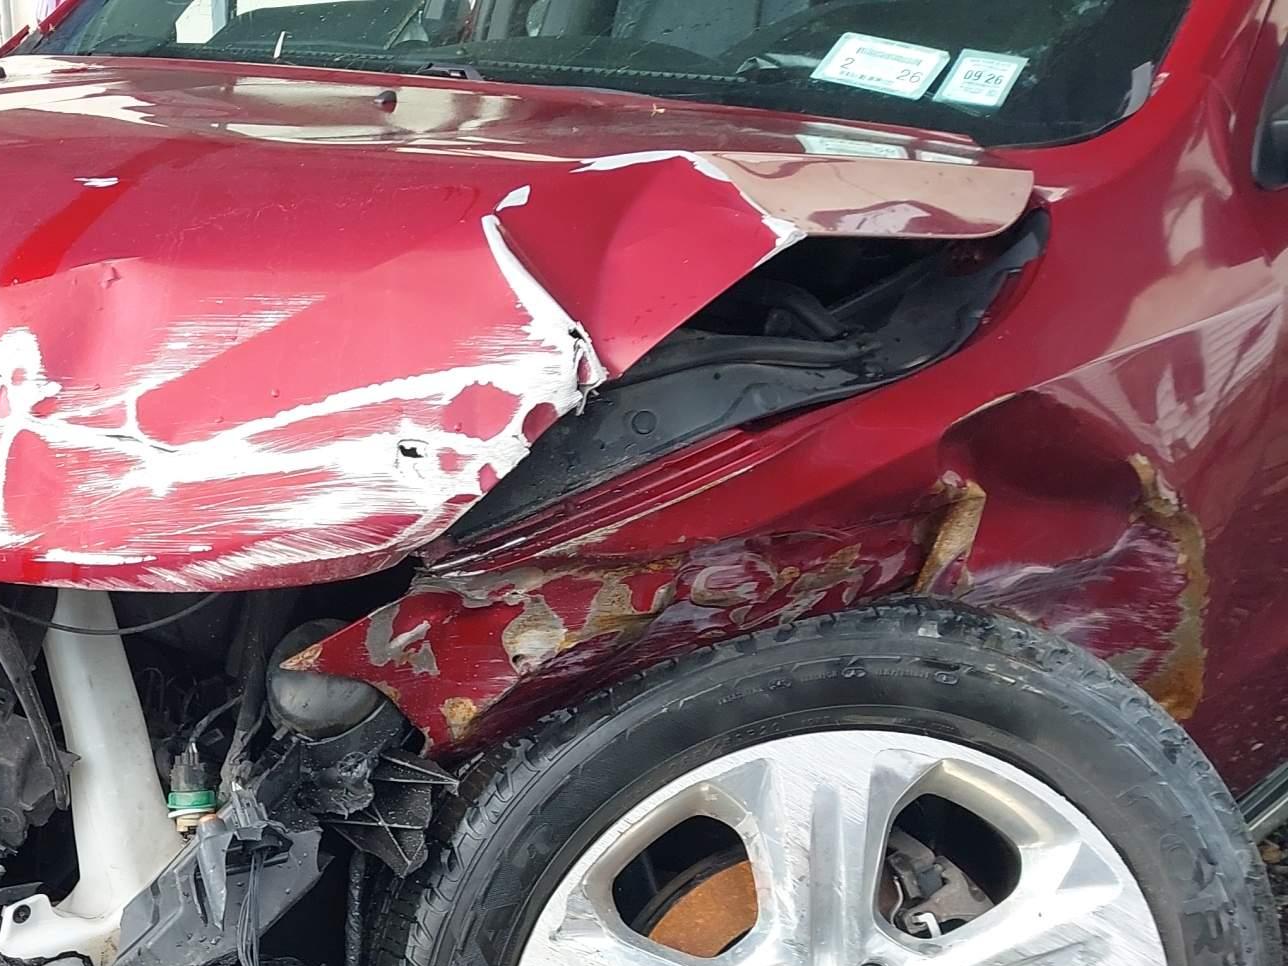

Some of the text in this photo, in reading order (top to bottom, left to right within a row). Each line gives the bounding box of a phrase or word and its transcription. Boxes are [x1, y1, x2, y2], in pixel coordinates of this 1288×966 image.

[839, 57, 857, 70] 2
[896, 69, 924, 84] 26
[963, 69, 1005, 85] 09 26
